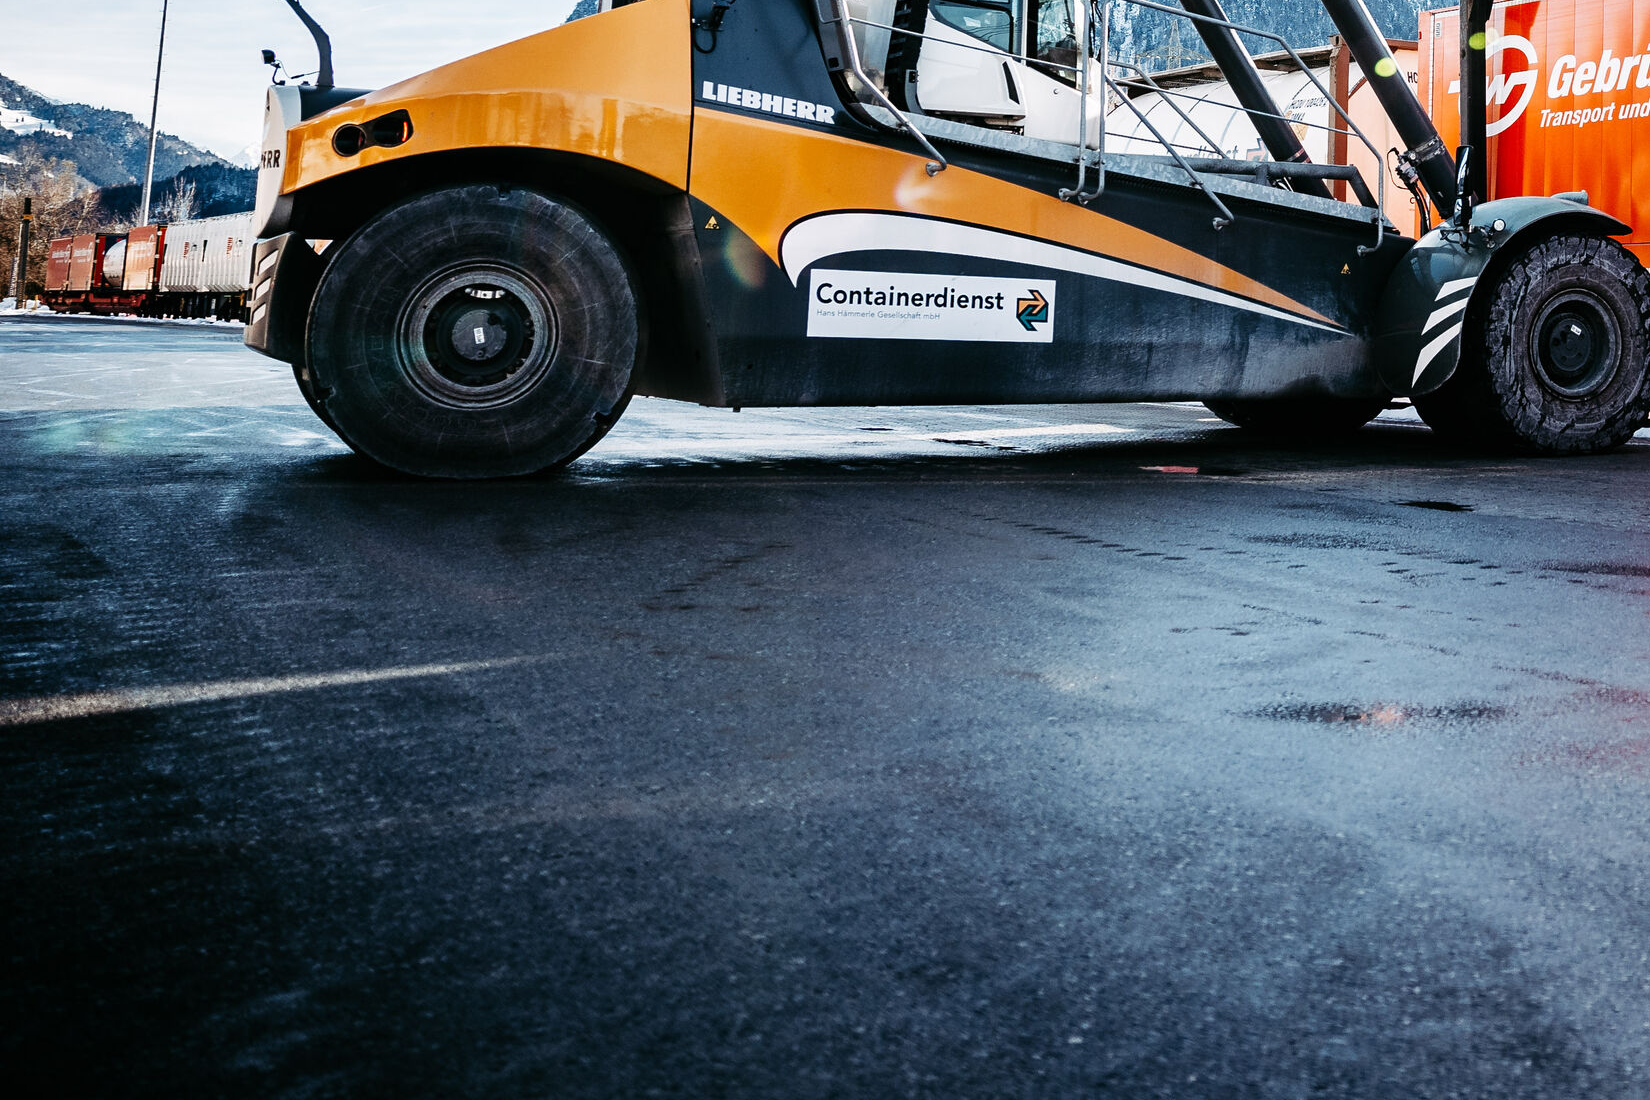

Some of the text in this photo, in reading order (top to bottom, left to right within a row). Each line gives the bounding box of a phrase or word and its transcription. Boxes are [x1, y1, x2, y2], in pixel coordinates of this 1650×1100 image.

[703, 80, 835, 125] LIEBHERR
[1540, 99, 1614, 129] Transport
[816, 282, 1005, 310] Containerdienst
[816, 309, 940, 320] Hans Hämmerle Gesellschaft mbH
